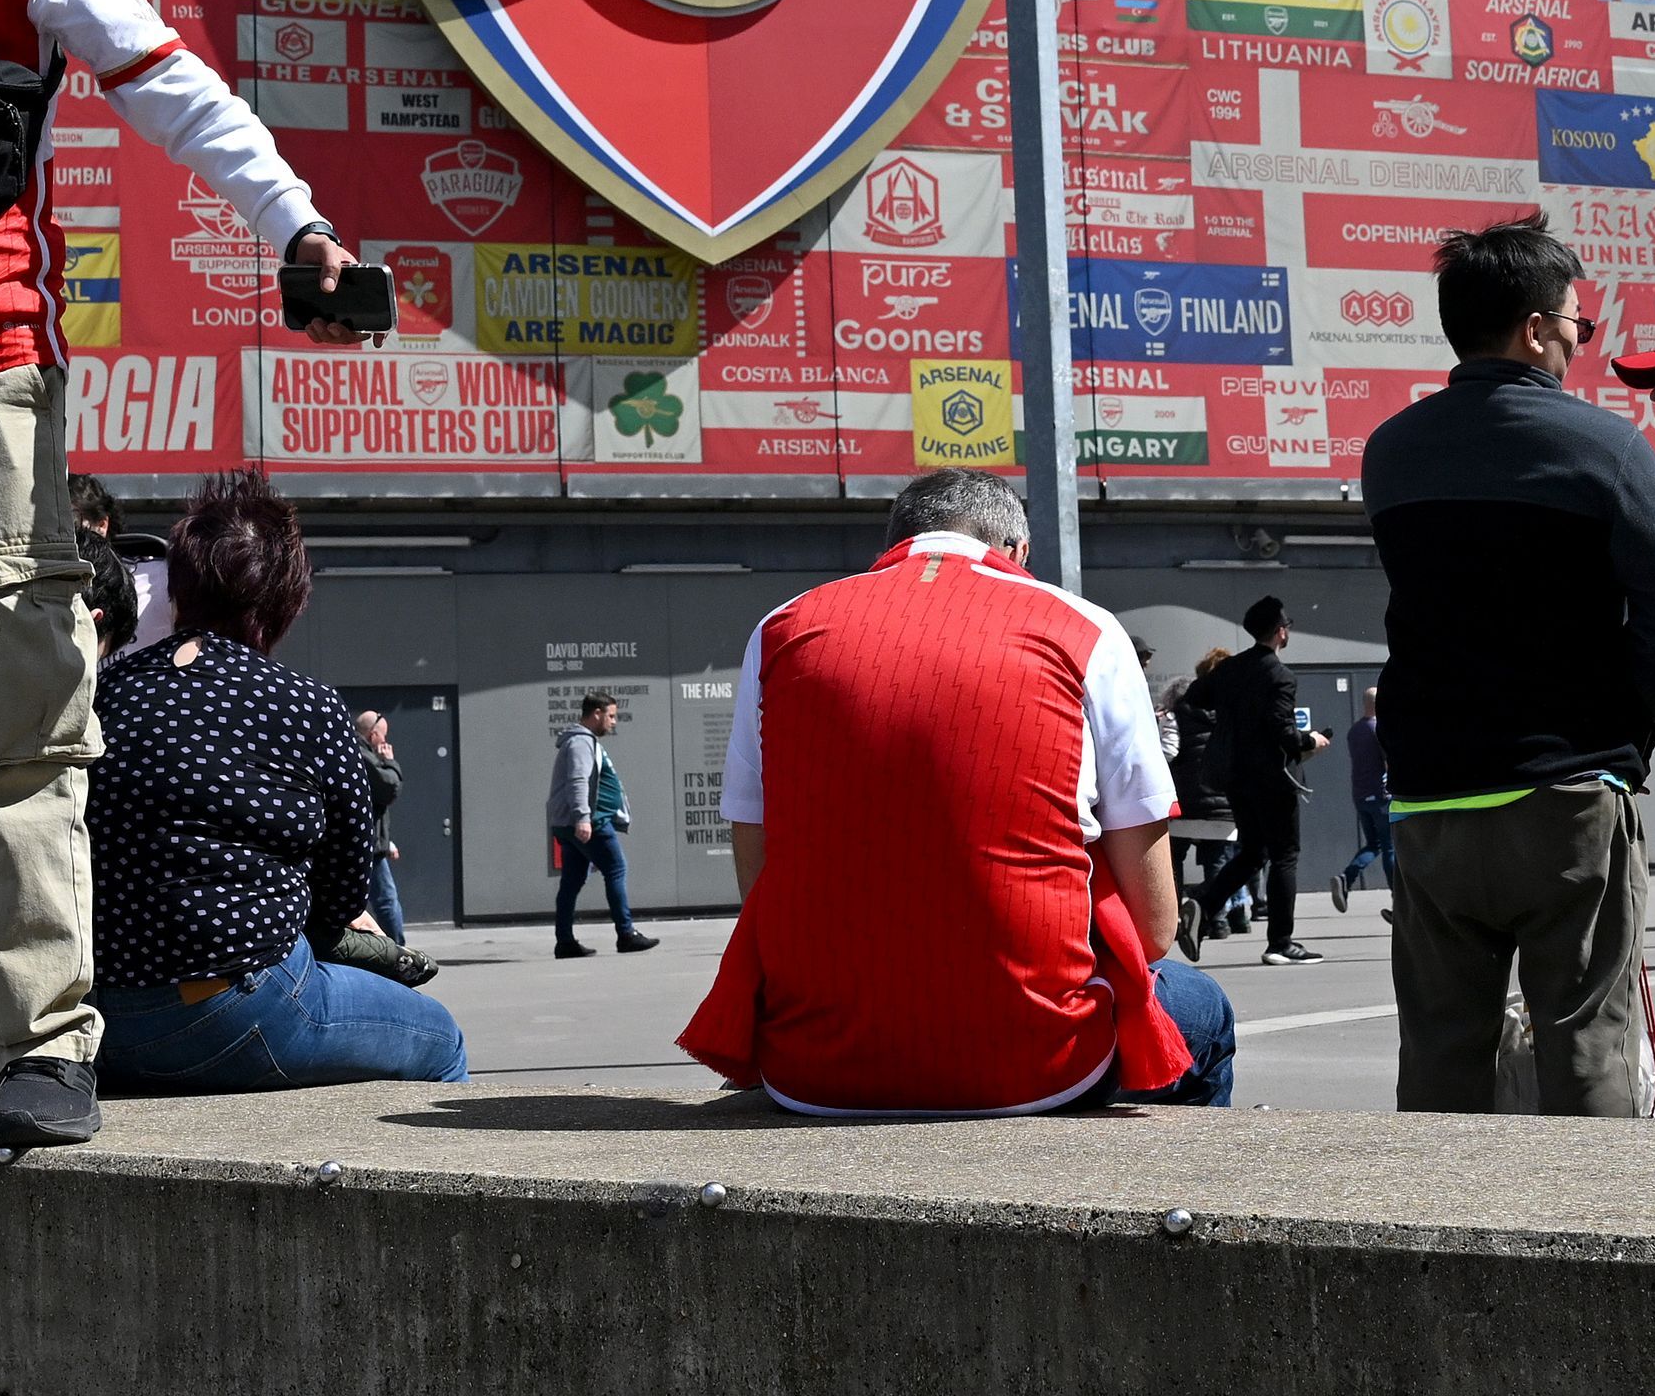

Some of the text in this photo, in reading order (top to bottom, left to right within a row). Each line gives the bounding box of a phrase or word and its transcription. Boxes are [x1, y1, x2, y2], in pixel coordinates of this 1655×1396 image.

[1202, 38, 1351, 68] LITHUANIA
[258, 63, 454, 87] THE ARSENAL
[402, 92, 439, 109] WEST
[1207, 90, 1241, 103] CWC
[381, 111, 460, 129] HAMPSTEAD
[1551, 126, 1616, 152] KOSOVO
[1207, 151, 1524, 194] ARSENAL DENMARK
[426, 173, 521, 199] PARAGUAY
[484, 273, 689, 322] CAMDEN GOONERS
[1181, 297, 1284, 334] FINLAND
[504, 322, 674, 345] ARE MAGIC
[712, 333, 790, 348] DUNDALK
[272, 358, 566, 407] ARSENAL WOMEN
[722, 366, 888, 385] COSTA BLANCA
[283, 408, 556, 454] SUPPORTERS CLUB
[547, 642, 637, 658] DAVID ROCASTLE
[682, 682, 732, 698] THE FANS
